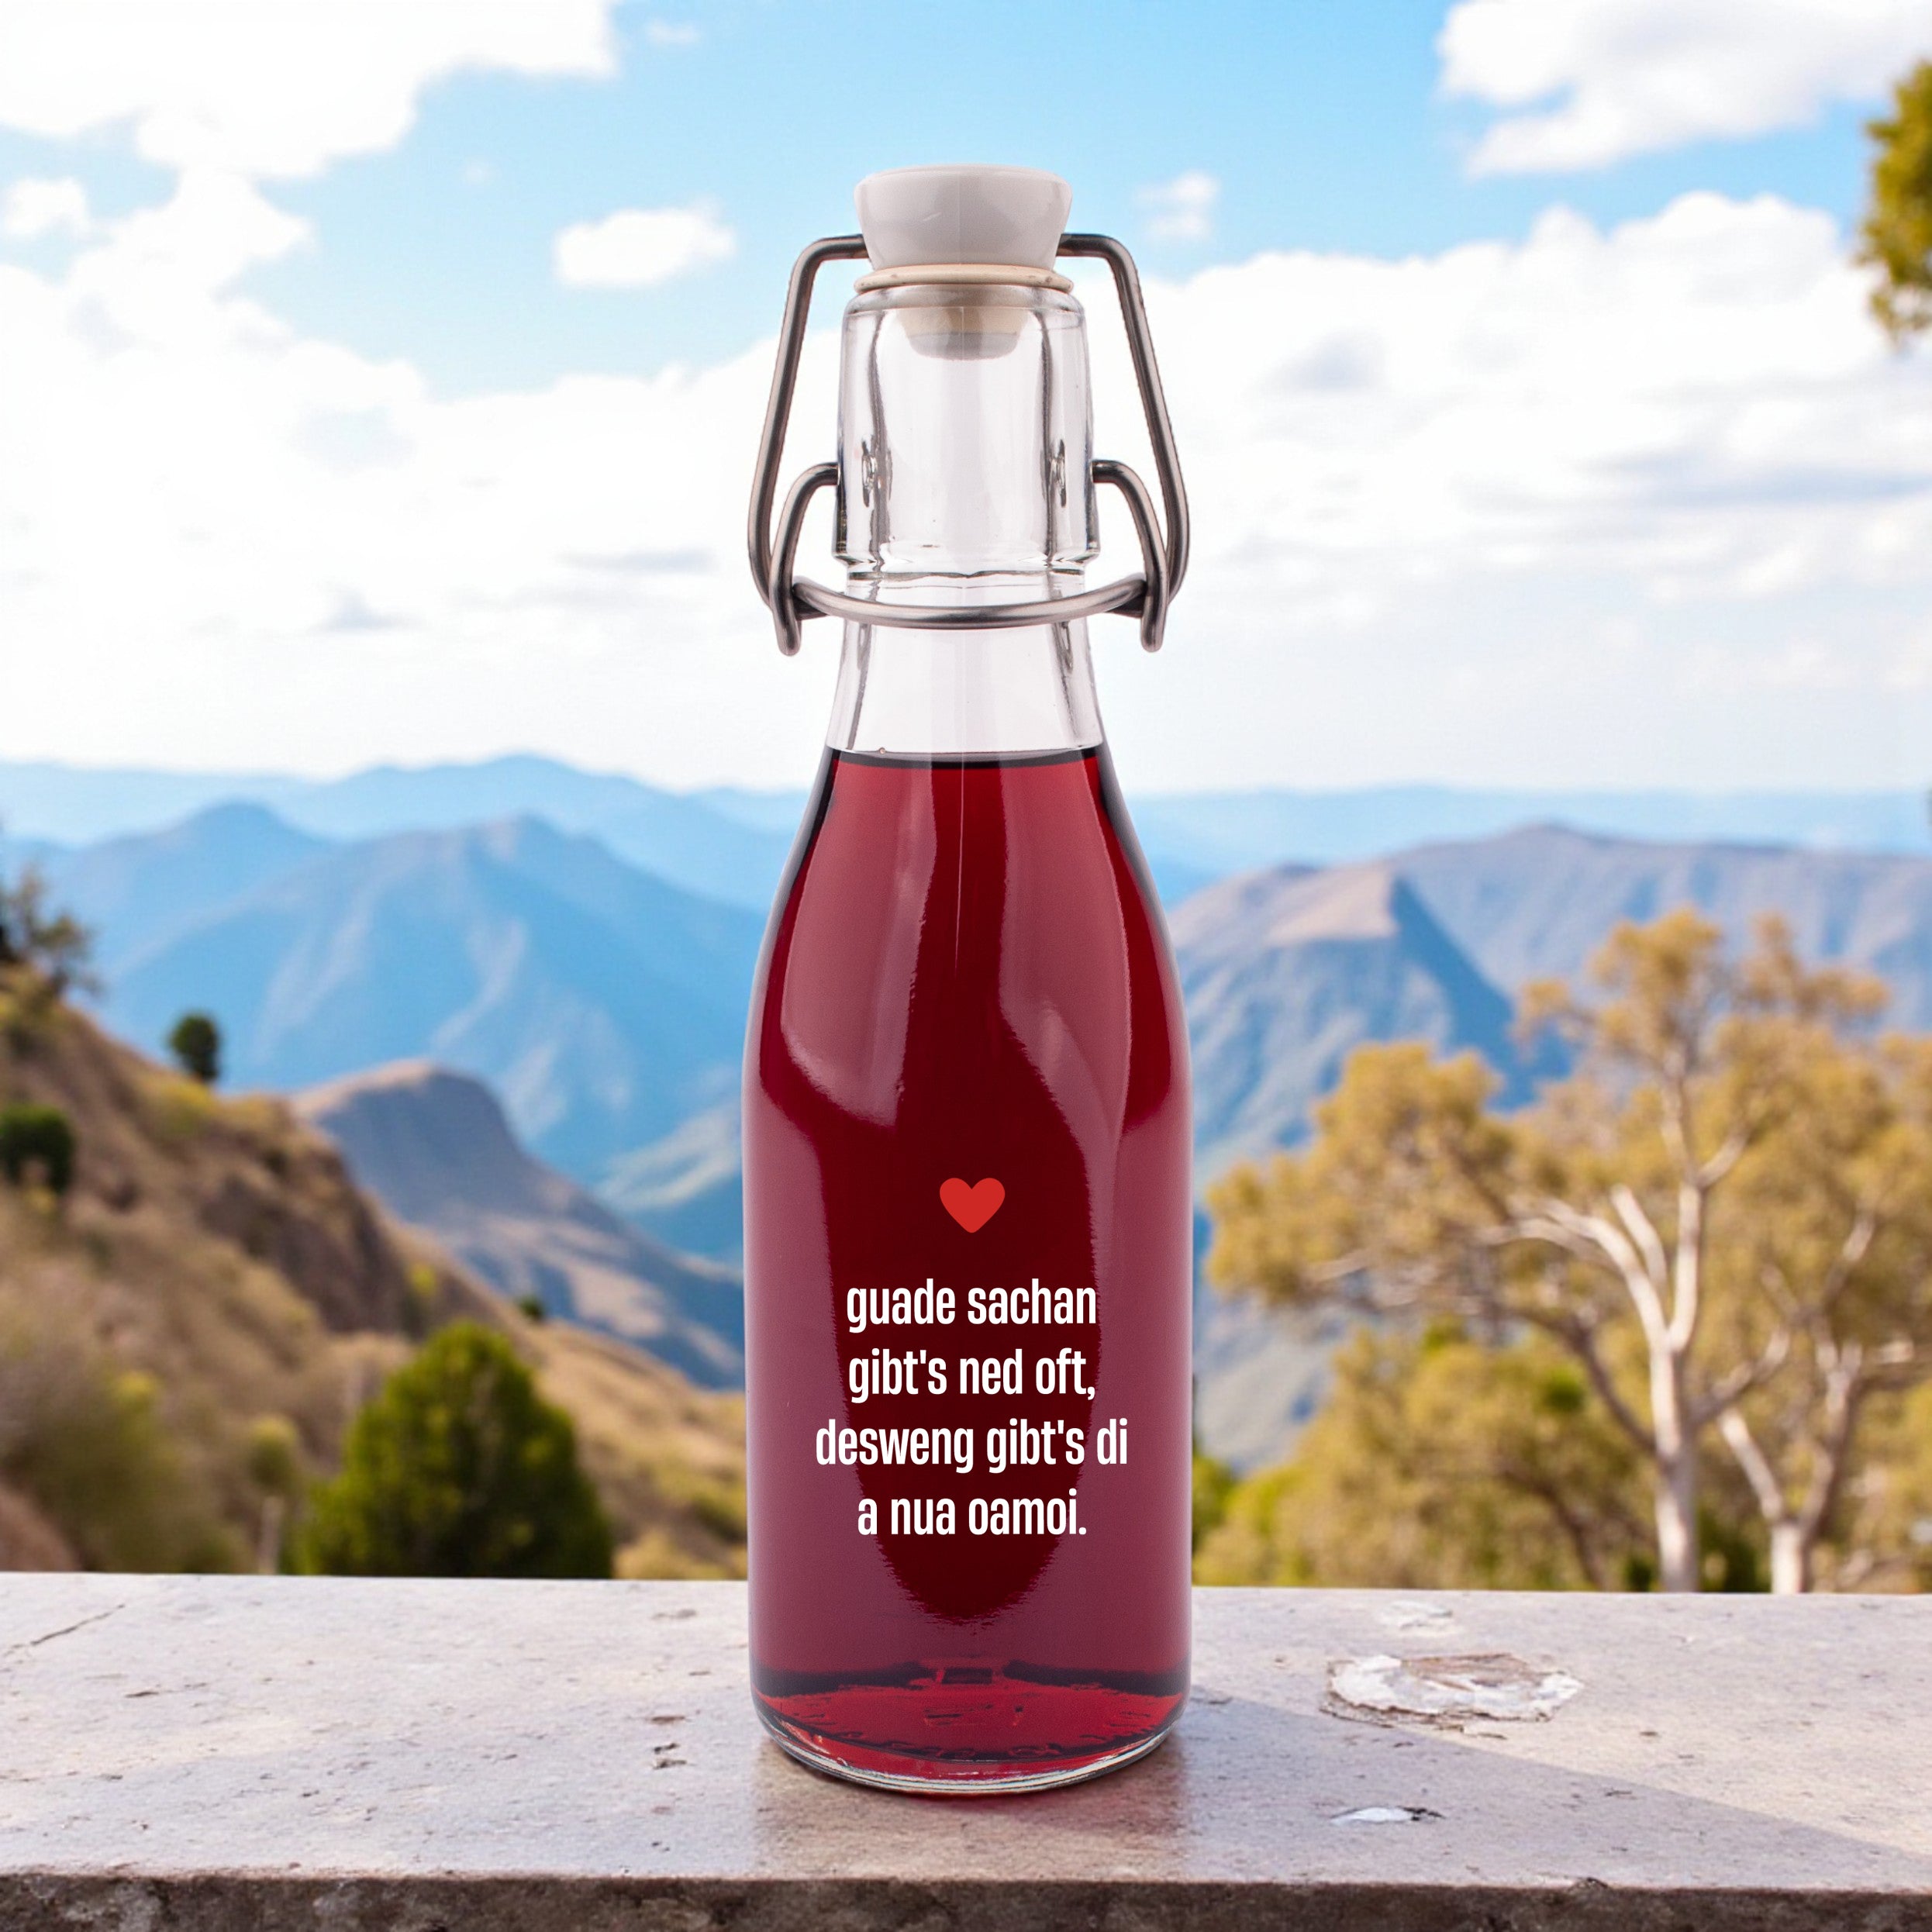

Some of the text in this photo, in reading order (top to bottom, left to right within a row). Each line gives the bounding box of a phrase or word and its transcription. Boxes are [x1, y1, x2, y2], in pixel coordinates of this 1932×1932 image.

[847, 1278, 1096, 1333] guade sachan
[849, 1347, 1095, 1404] gibt's ned oft,
[816, 1417, 1128, 1474] desweng gibt's di
[857, 1488, 1087, 1536] a nua oamoi.
